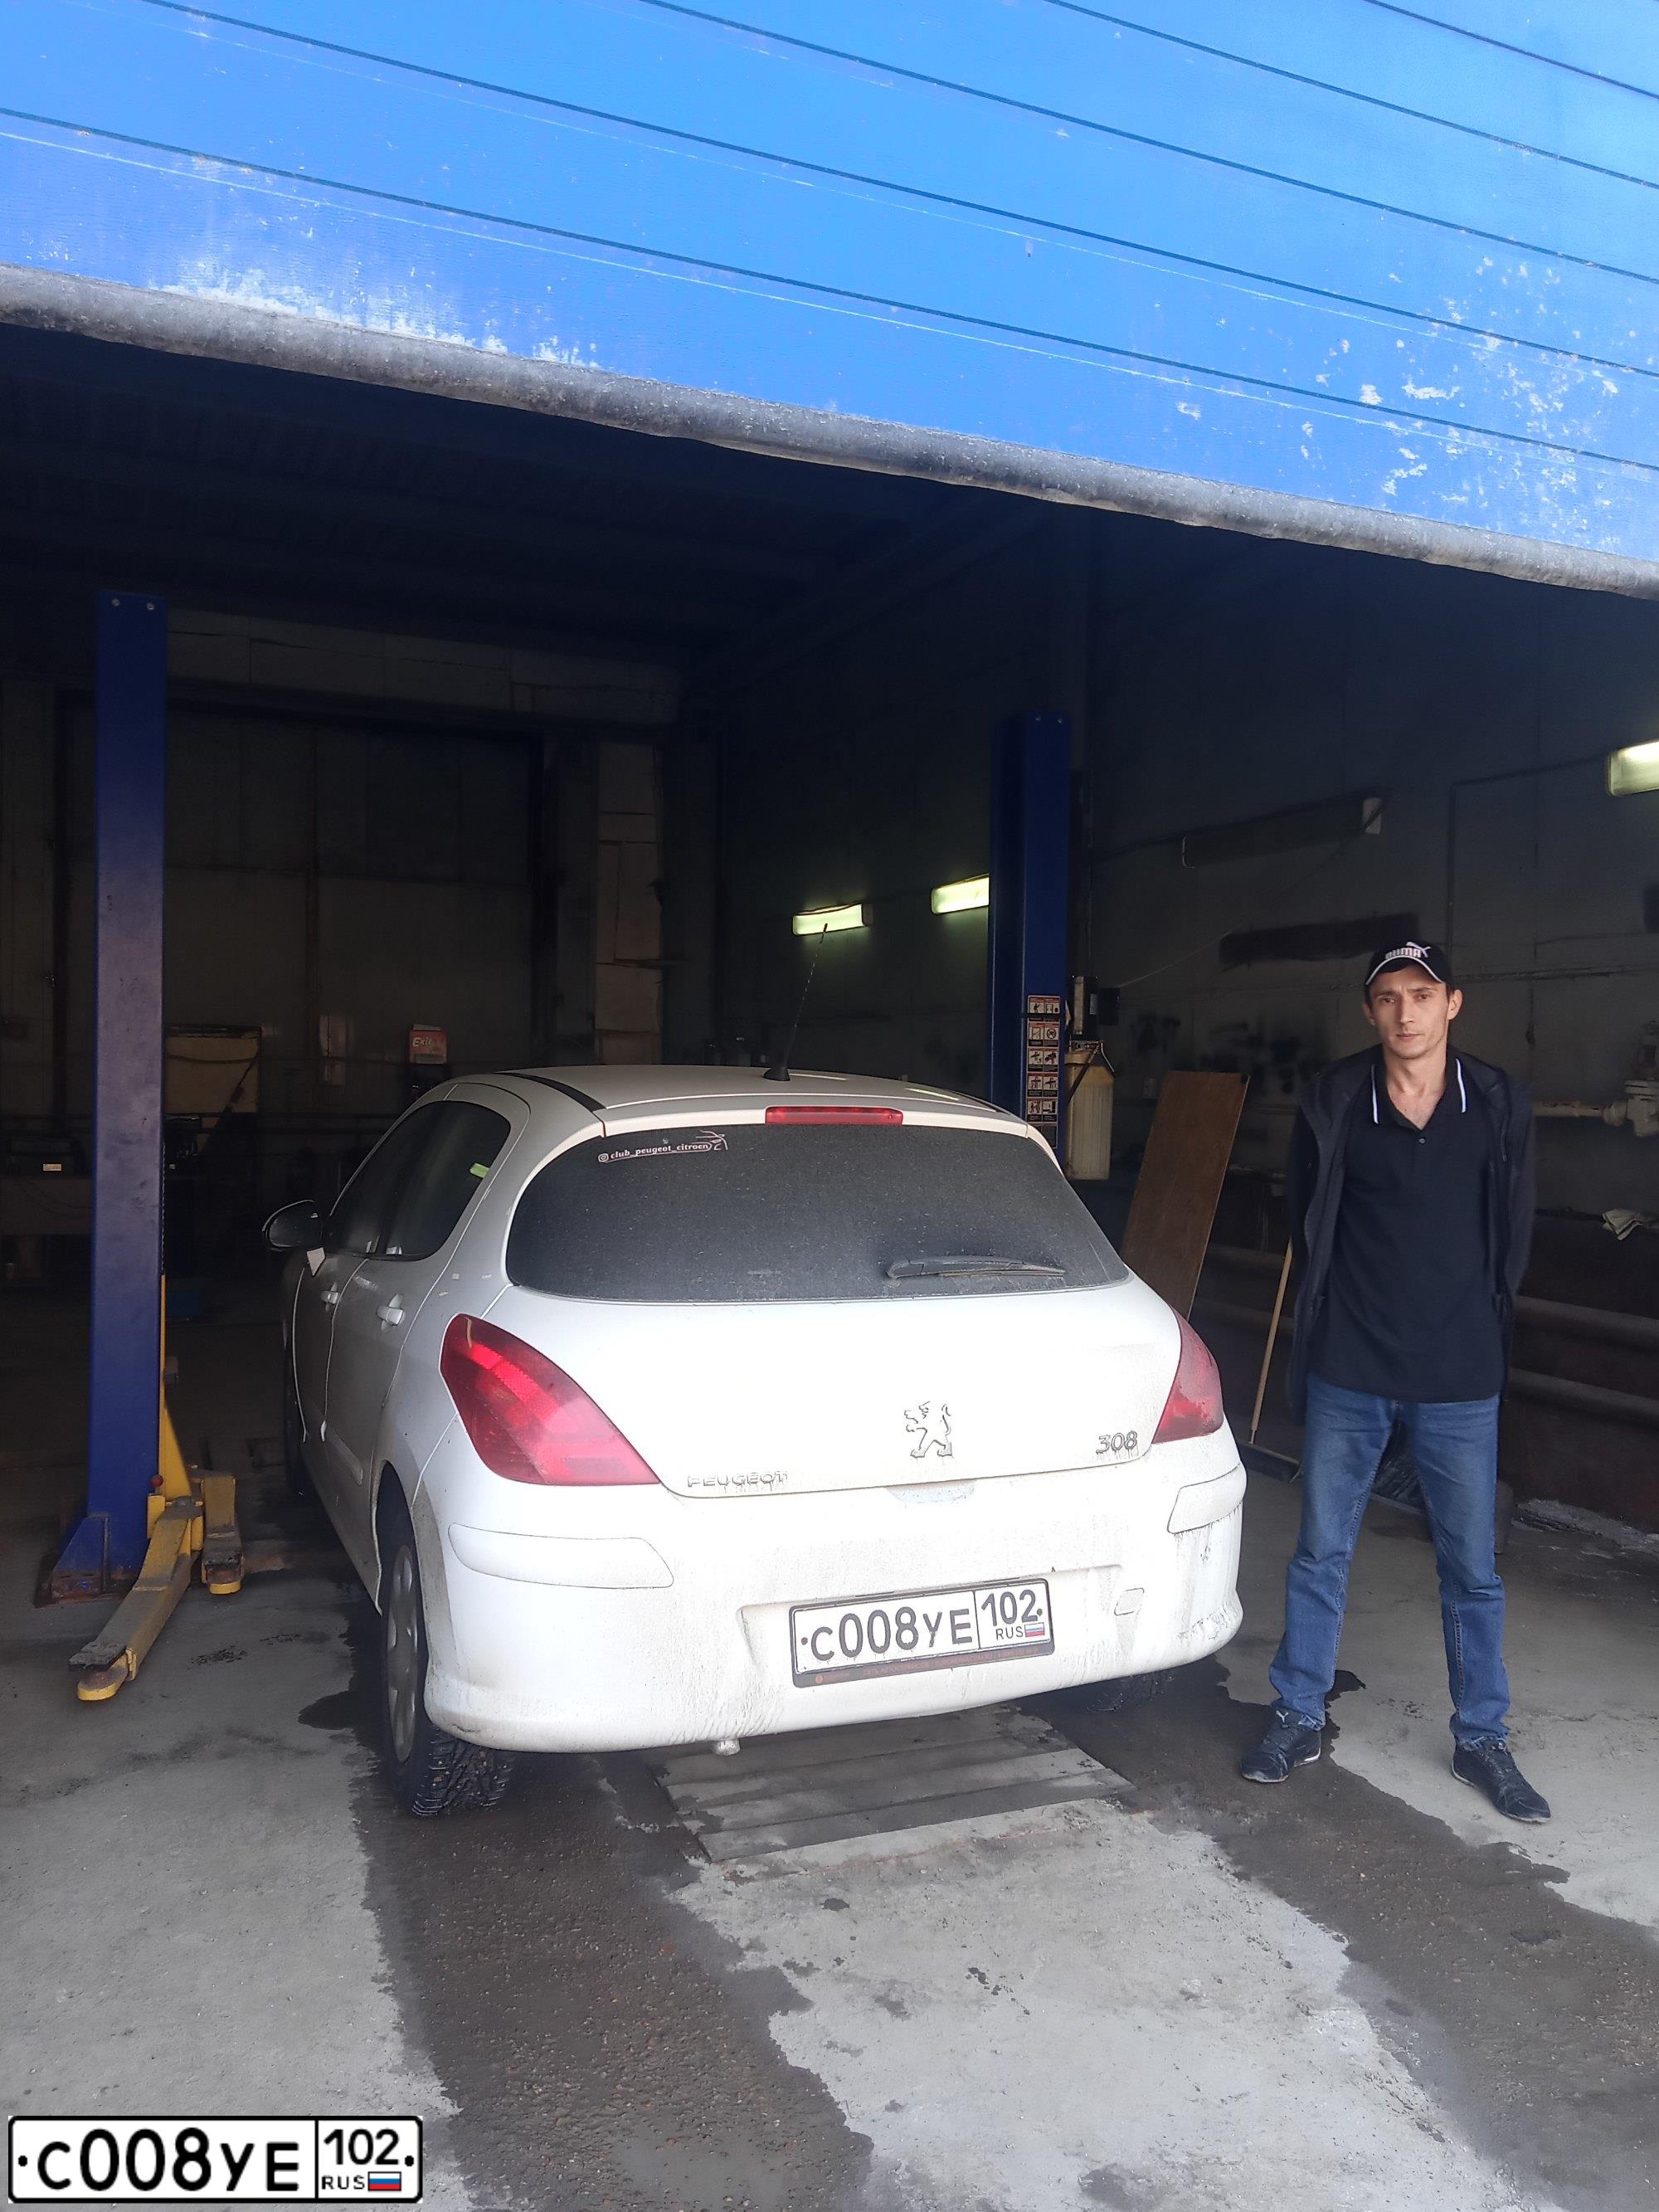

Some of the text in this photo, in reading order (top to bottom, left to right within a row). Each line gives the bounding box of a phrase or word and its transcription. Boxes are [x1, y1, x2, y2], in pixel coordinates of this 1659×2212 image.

[1096, 1430, 1137, 1454] 308
[688, 1470, 787, 1488] PEUGEOT
[981, 1589, 1039, 1627] 102
[995, 1625, 1024, 1641] RUS
